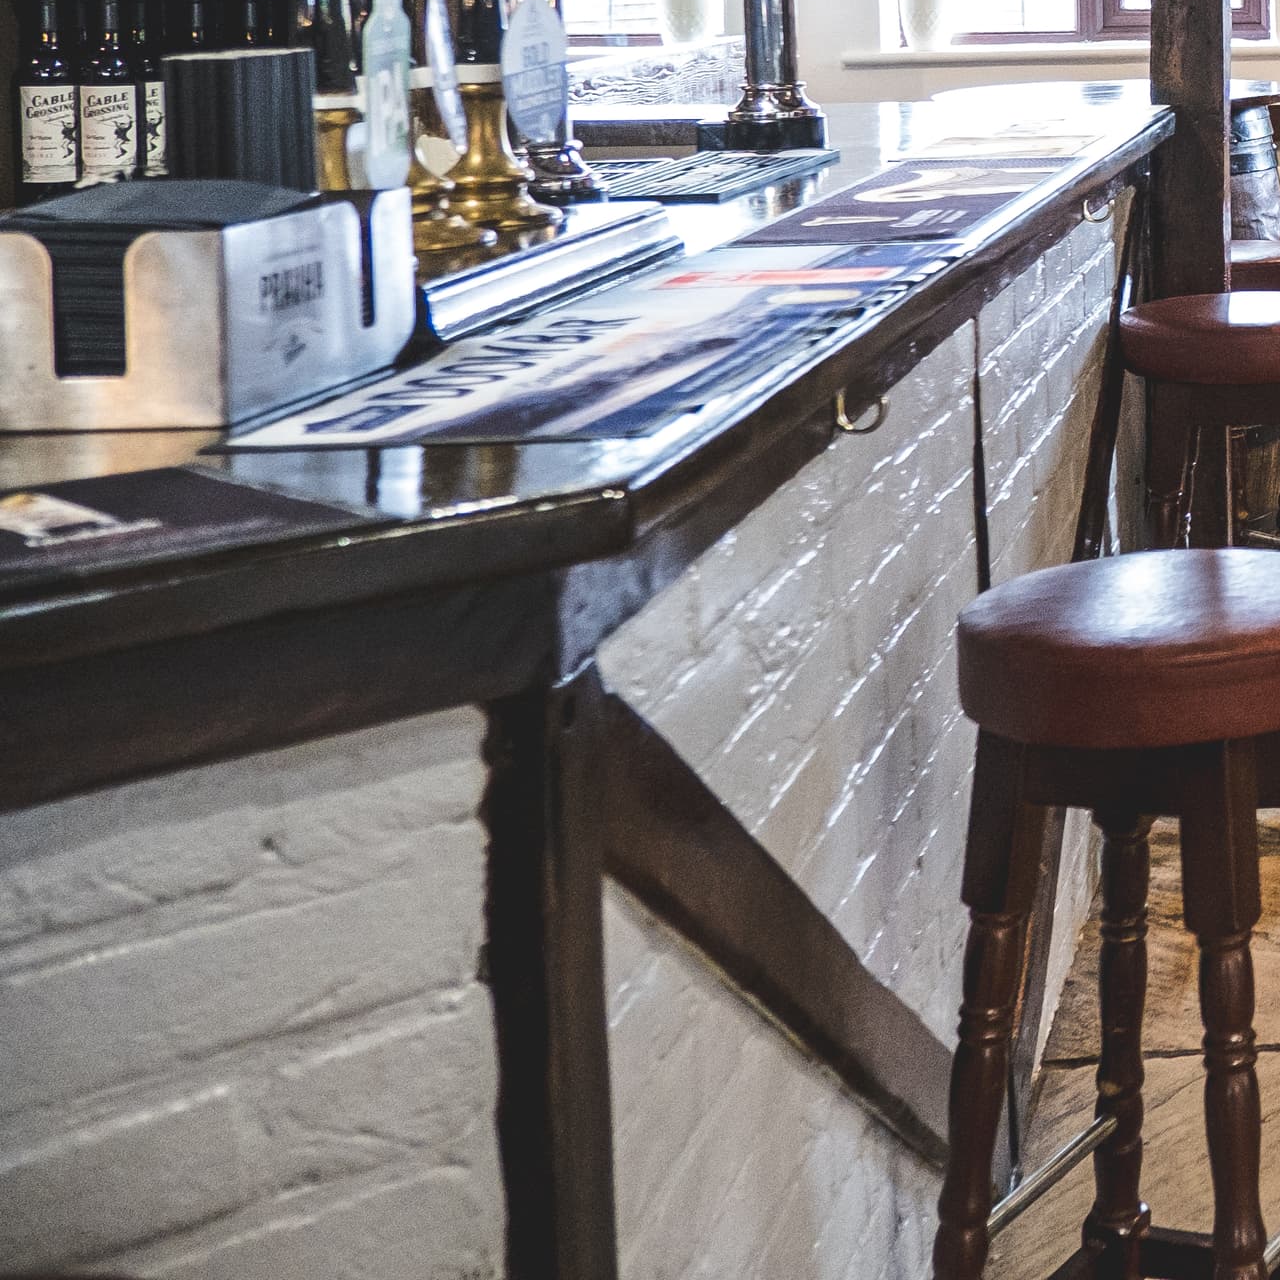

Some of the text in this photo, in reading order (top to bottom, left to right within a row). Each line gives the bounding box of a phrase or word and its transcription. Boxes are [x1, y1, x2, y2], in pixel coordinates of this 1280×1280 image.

[32, 91, 74, 108] CABLE
[87, 91, 129, 108] CABLE
[82, 103, 129, 119] CROSSING
